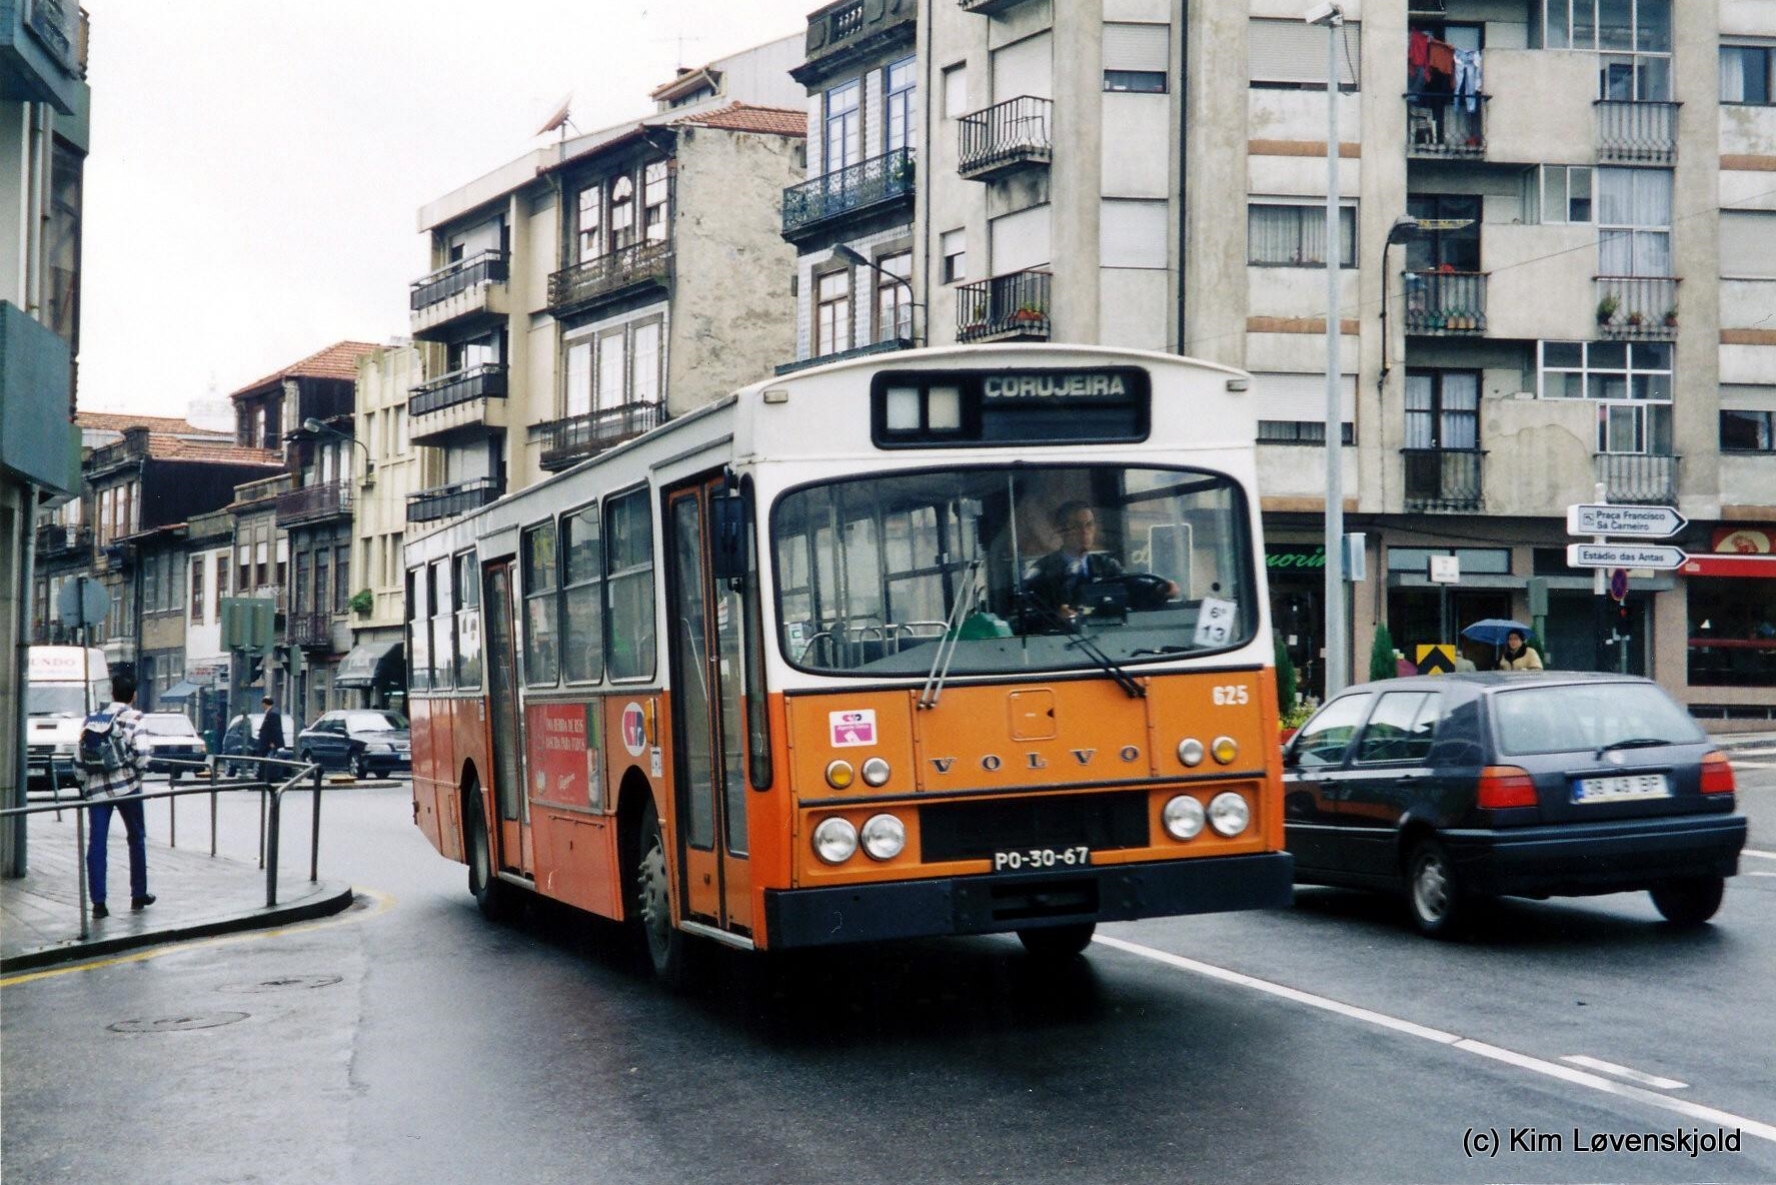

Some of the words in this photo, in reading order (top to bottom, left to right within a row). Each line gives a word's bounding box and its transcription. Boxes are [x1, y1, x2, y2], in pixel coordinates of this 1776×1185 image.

[984, 375, 1125, 397] CORUJEIRA
[1596, 510, 1621, 521] Praça
[1623, 511, 1665, 521] Francisco
[1611, 521, 1649, 531] Carneiro
[1583, 551, 1616, 561] Estádio
[1620, 551, 1635, 561] das
[1639, 551, 1664, 562] Antas
[1212, 685, 1249, 706] 625
[929, 745, 1140, 774] VOLVO
[994, 847, 1089, 871] PO-30-67
